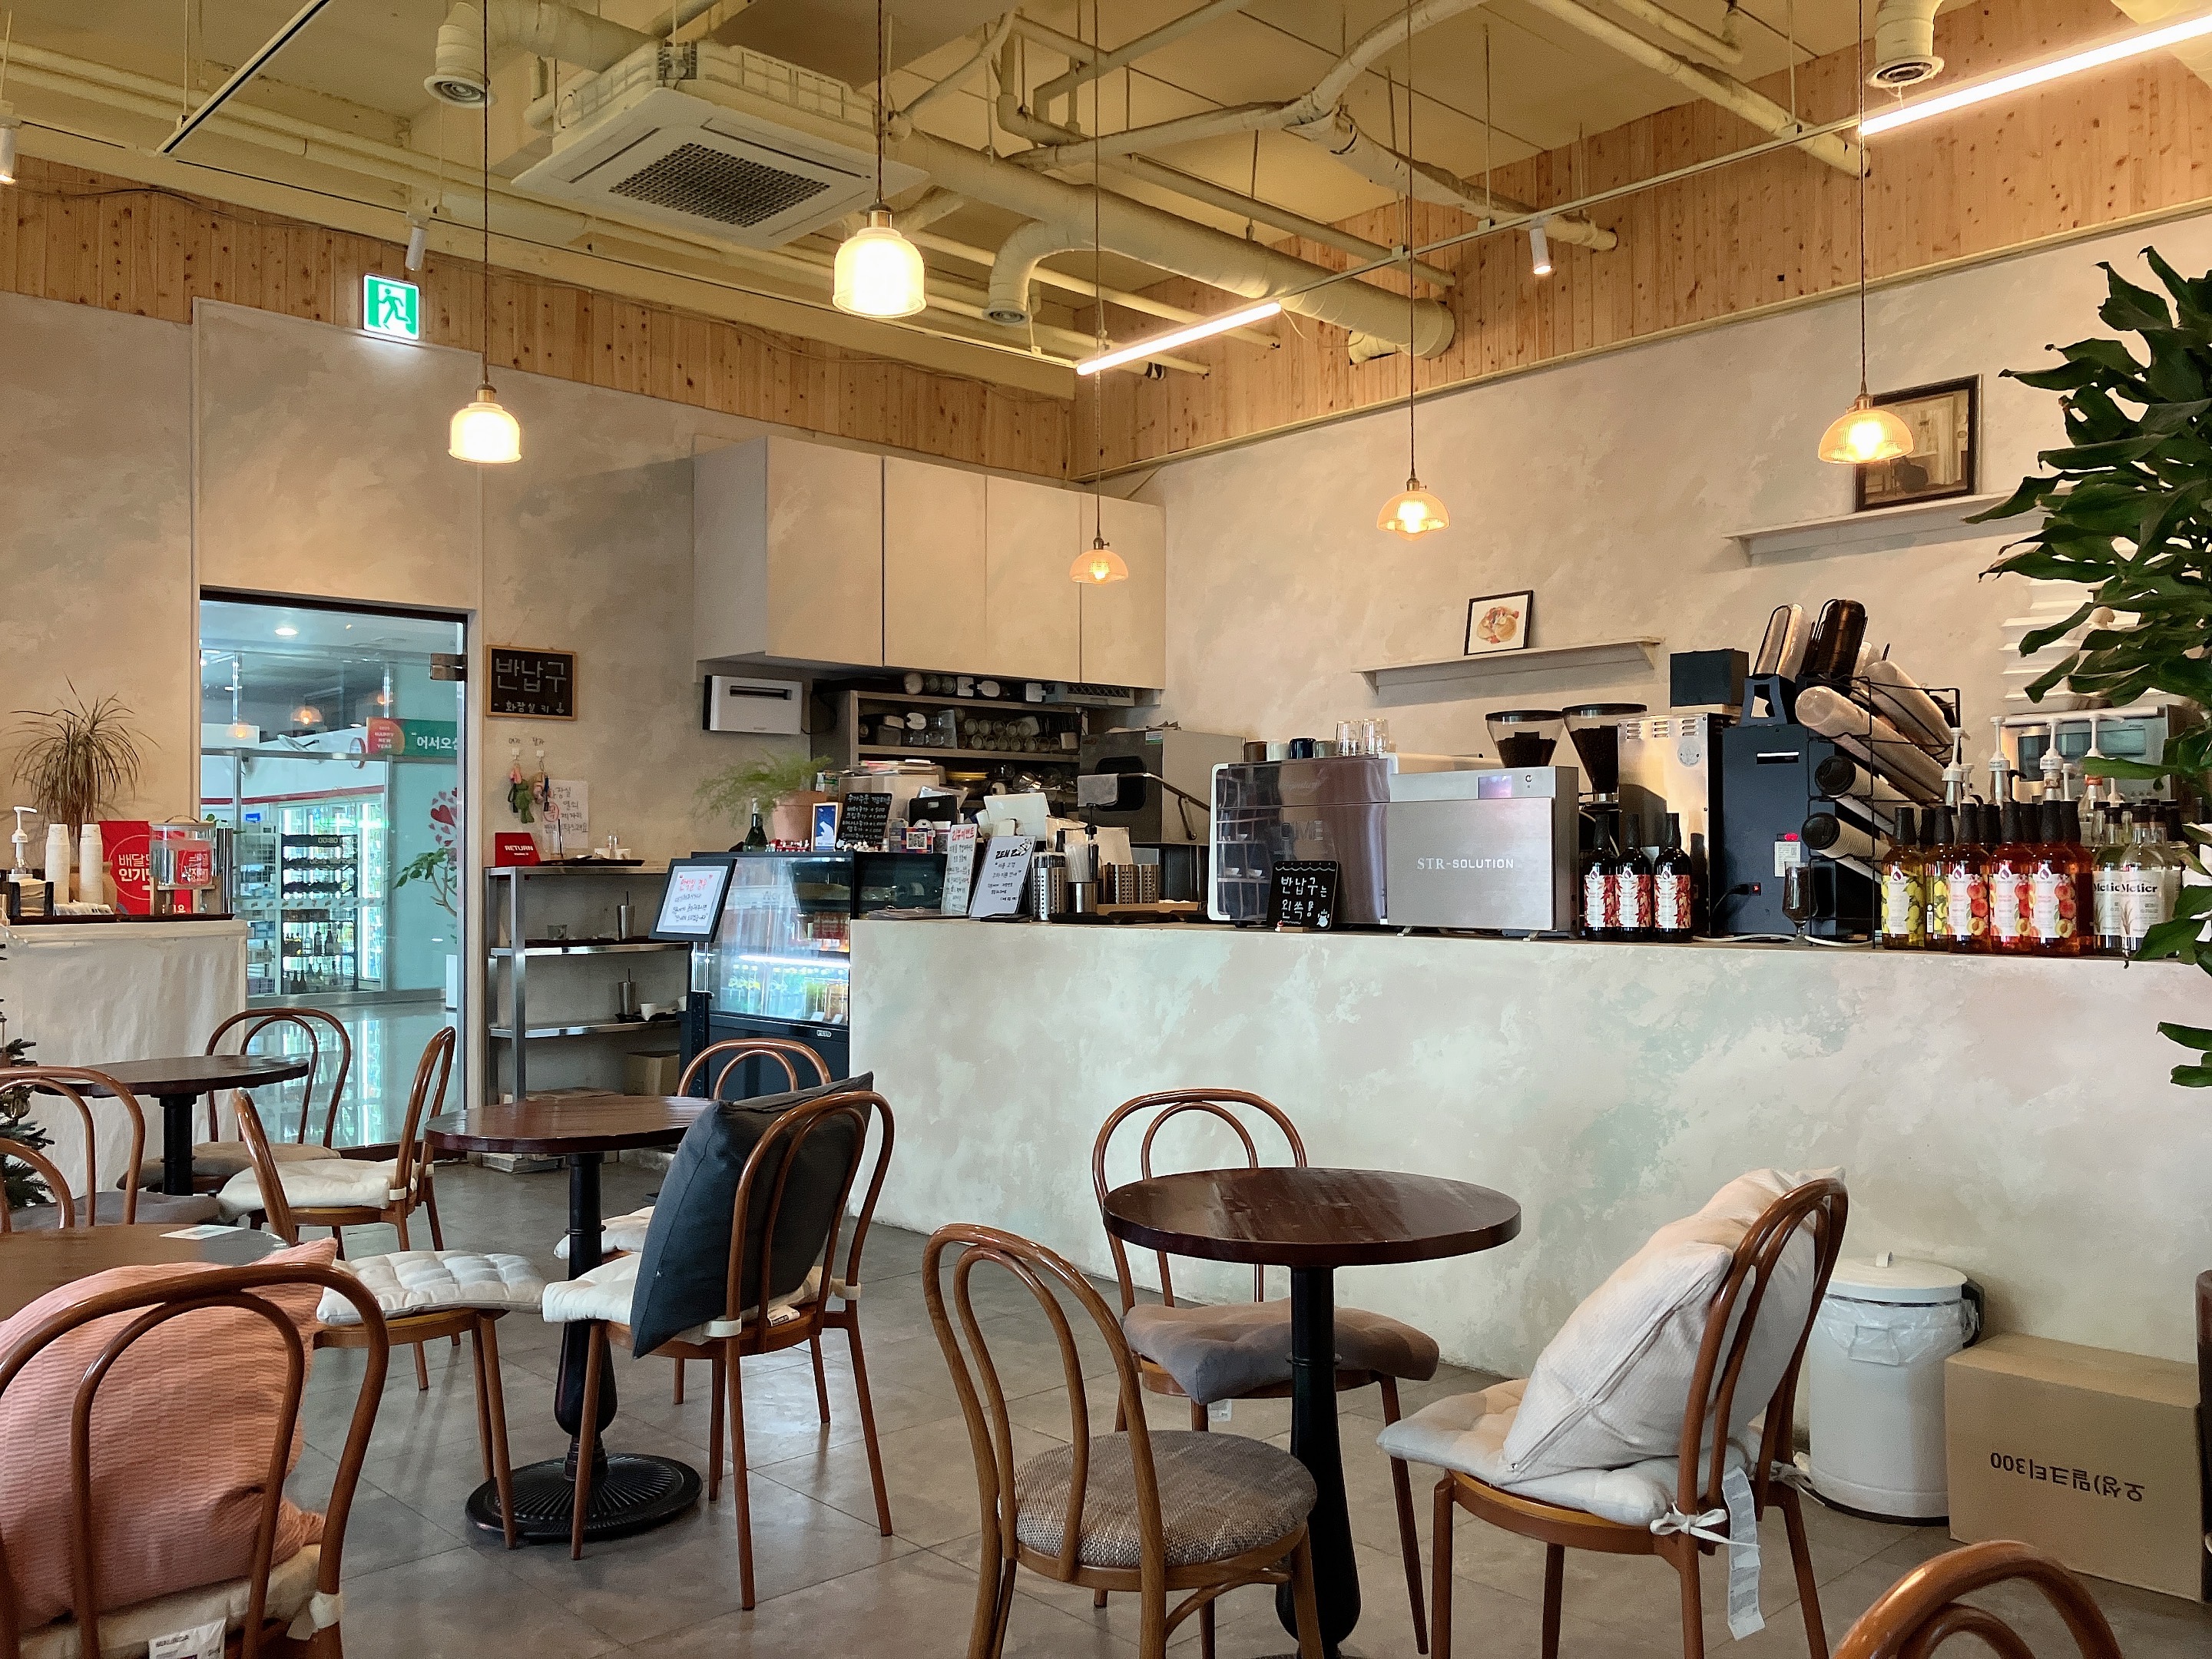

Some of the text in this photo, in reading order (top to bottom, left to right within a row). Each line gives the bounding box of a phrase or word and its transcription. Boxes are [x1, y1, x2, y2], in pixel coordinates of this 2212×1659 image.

[495, 658, 567, 692] 반납구
[506, 700, 535, 714] 화장실
[551, 786, 571, 799] 장실
[1417, 857, 1514, 869] STR-SOLUTION
[2121, 883, 2158, 892] Metier
[1990, 1452, 2145, 1502] 오성)밀크티300
